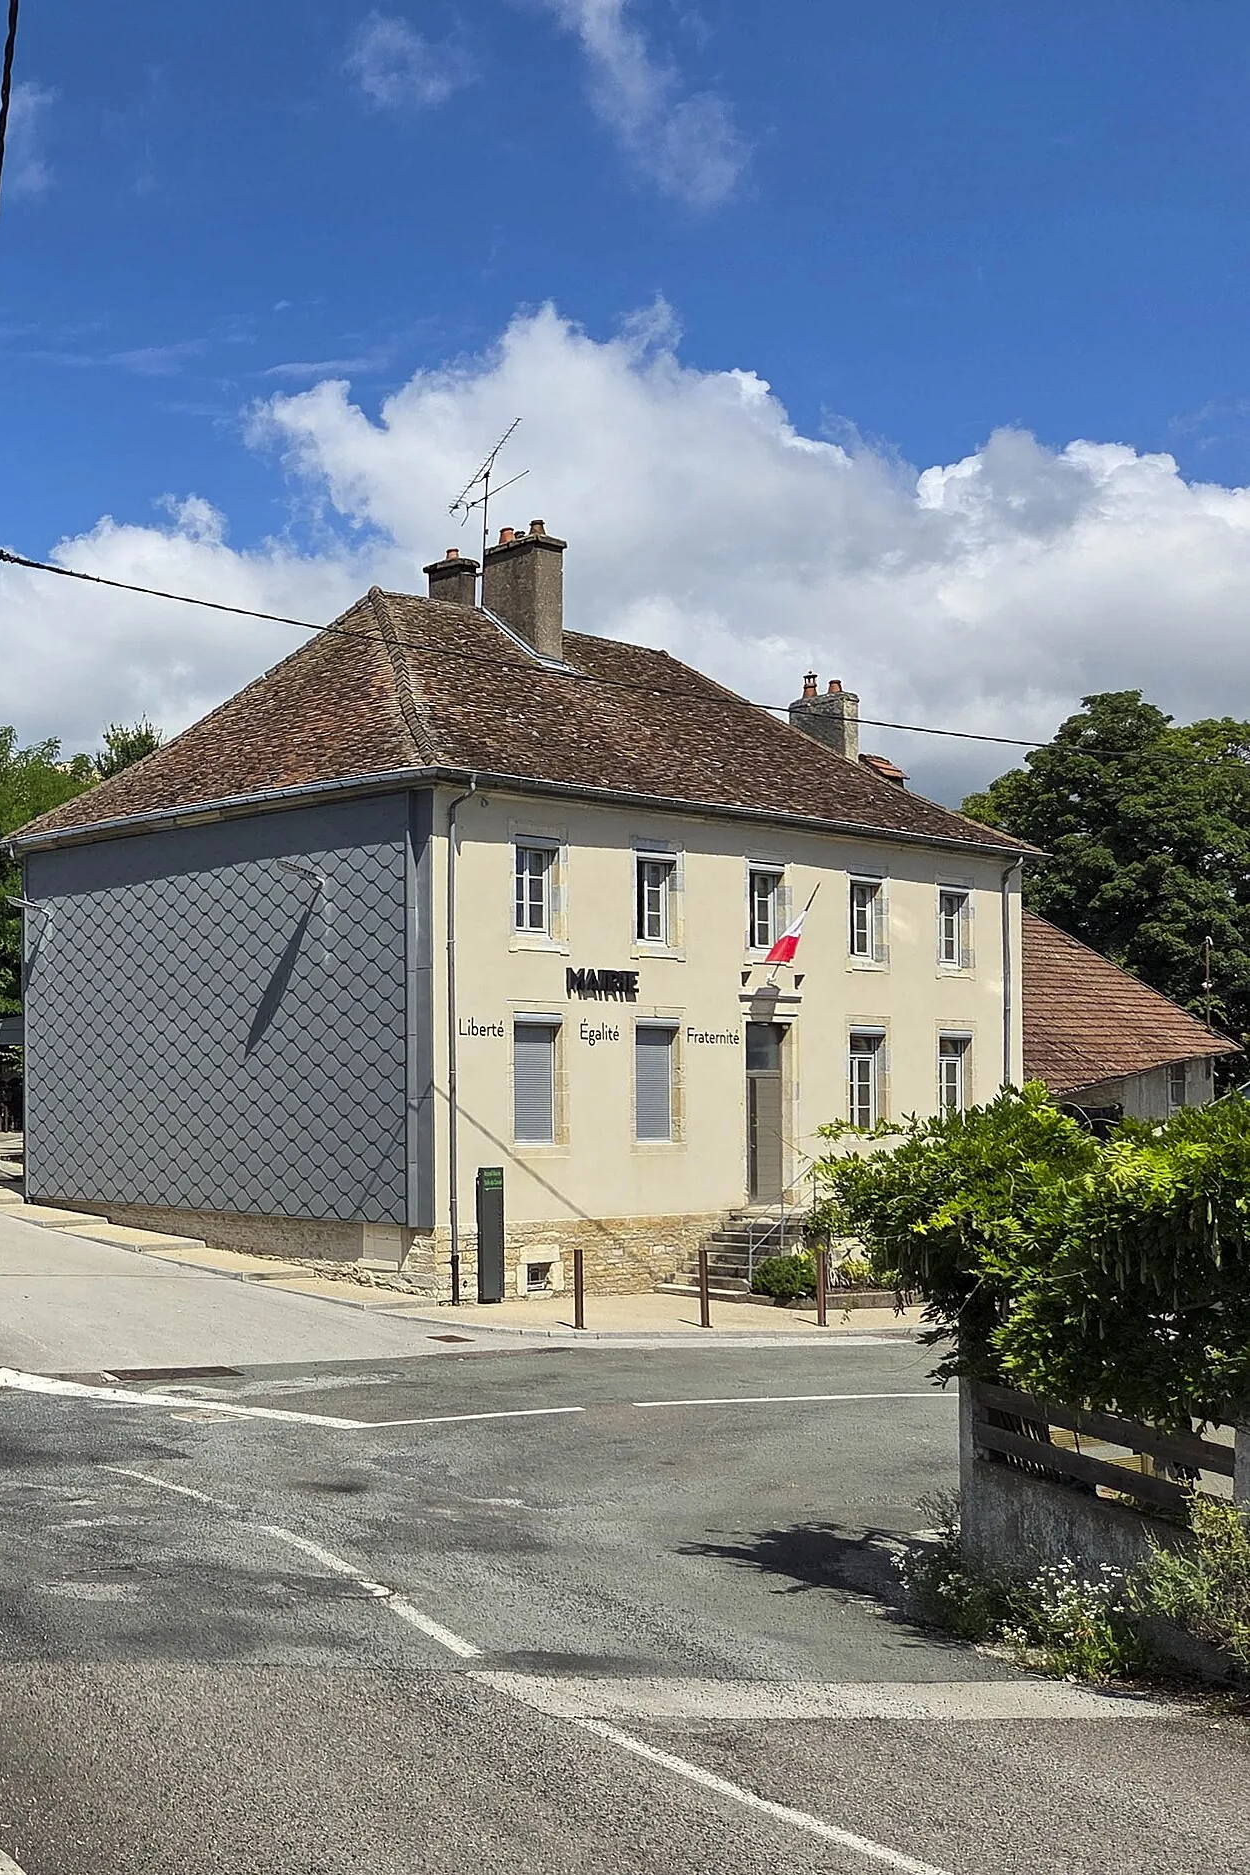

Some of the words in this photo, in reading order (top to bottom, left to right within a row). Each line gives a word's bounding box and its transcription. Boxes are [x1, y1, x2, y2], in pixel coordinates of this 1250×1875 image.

[565, 967, 640, 994] MAIRIE
[458, 1018, 505, 1038] Liberté
[580, 1018, 620, 1046] Égalité
[686, 1026, 740, 1045] Fraternité
